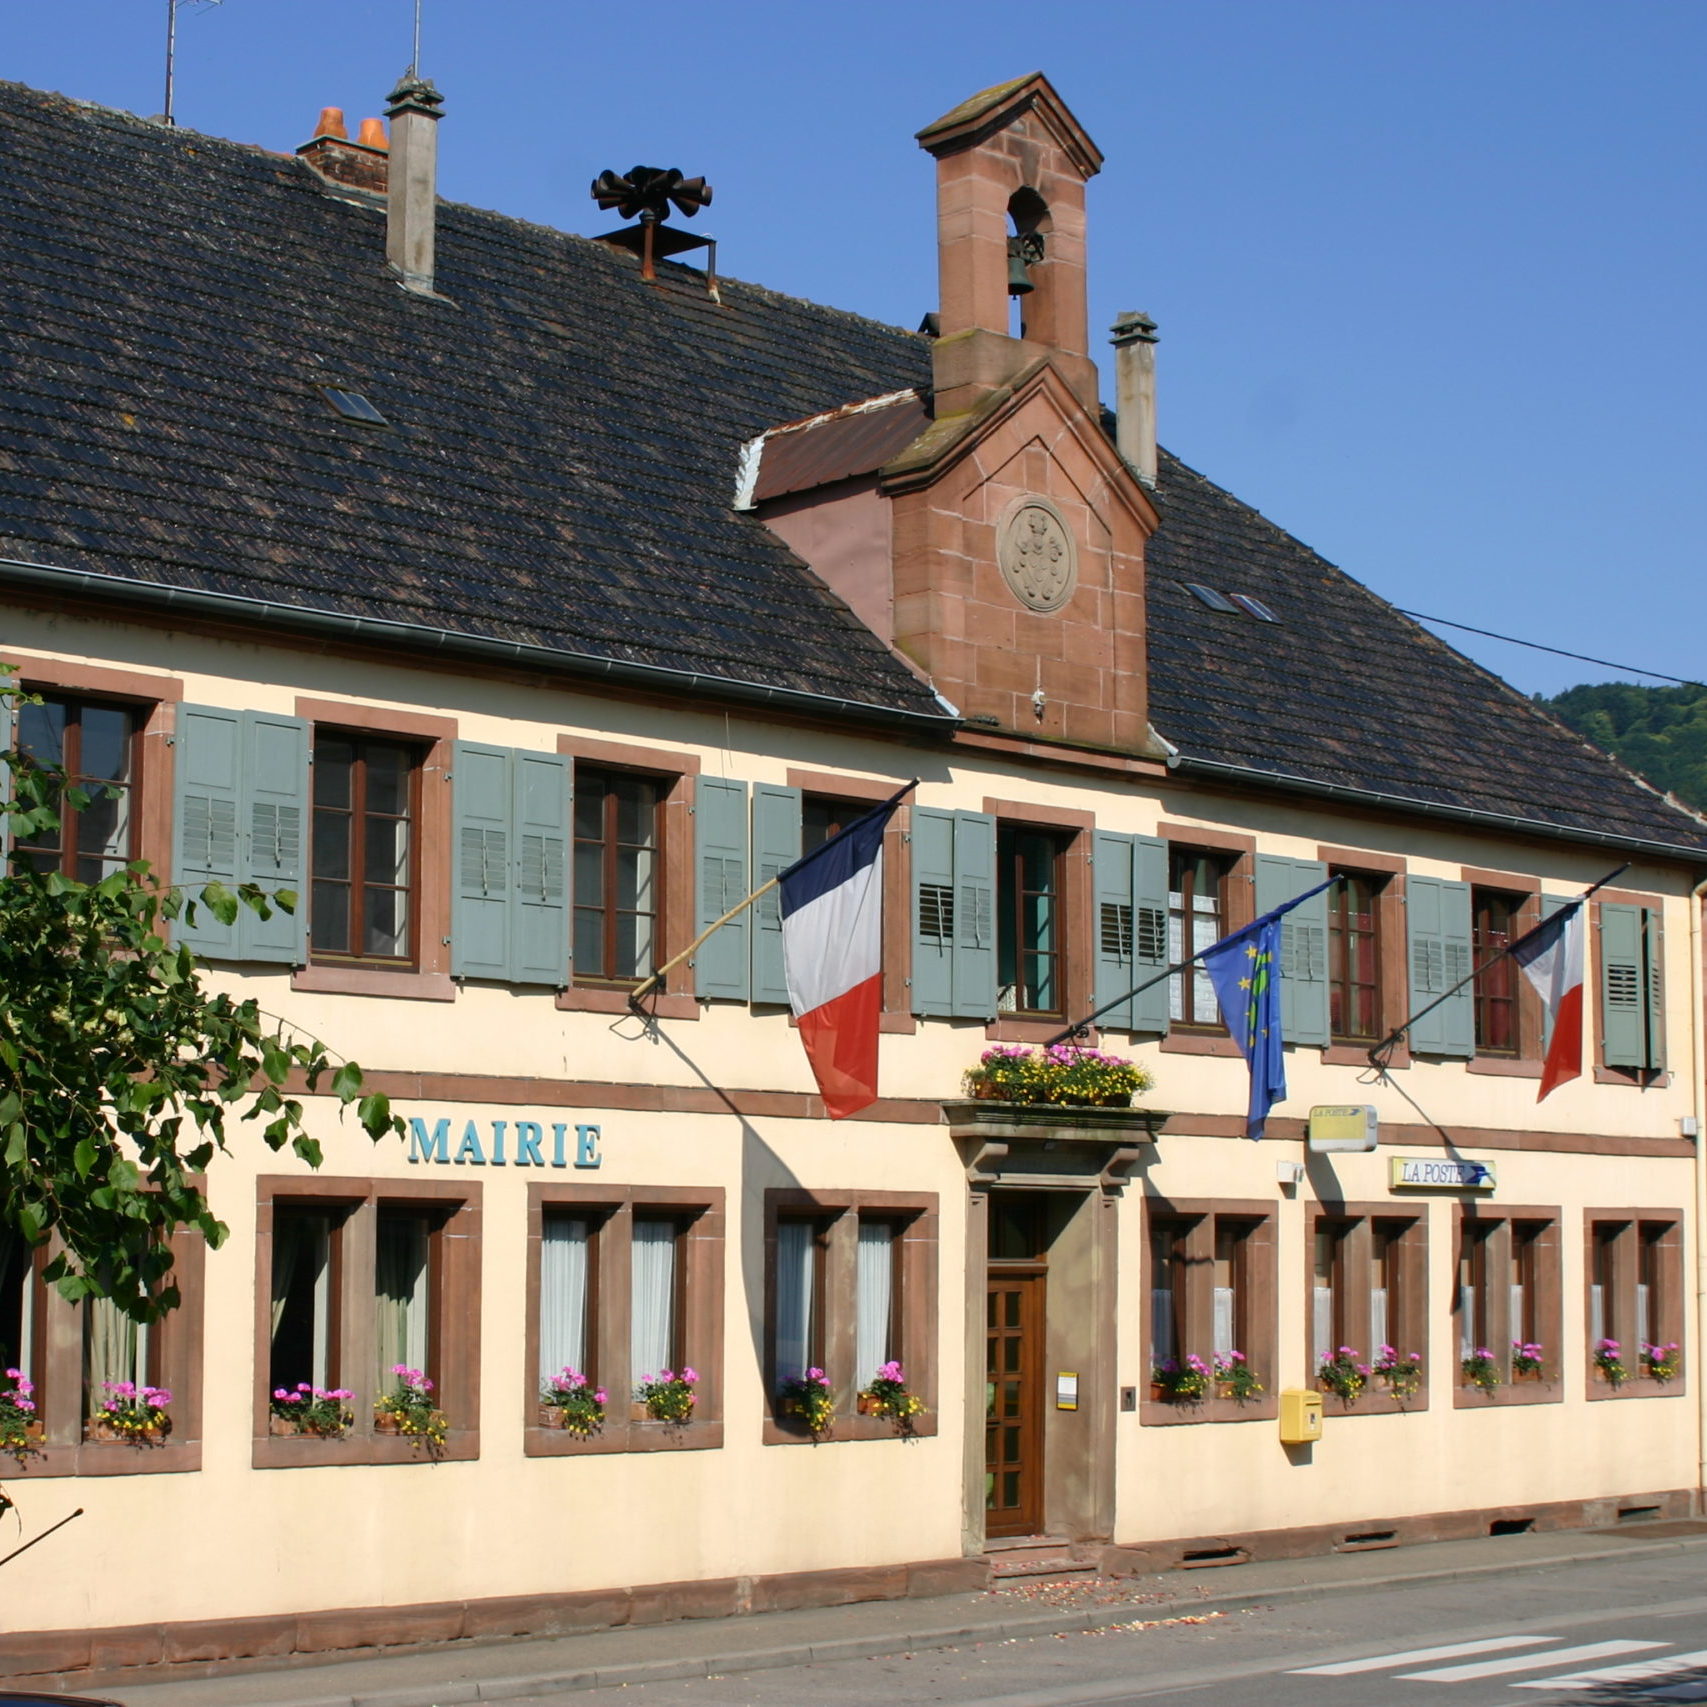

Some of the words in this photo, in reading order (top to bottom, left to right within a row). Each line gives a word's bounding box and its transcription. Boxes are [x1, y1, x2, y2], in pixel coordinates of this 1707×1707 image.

[408, 1117, 602, 1169] MAIRIE
[1401, 1163, 1420, 1182] LA
[1424, 1163, 1465, 1184] POSTE
